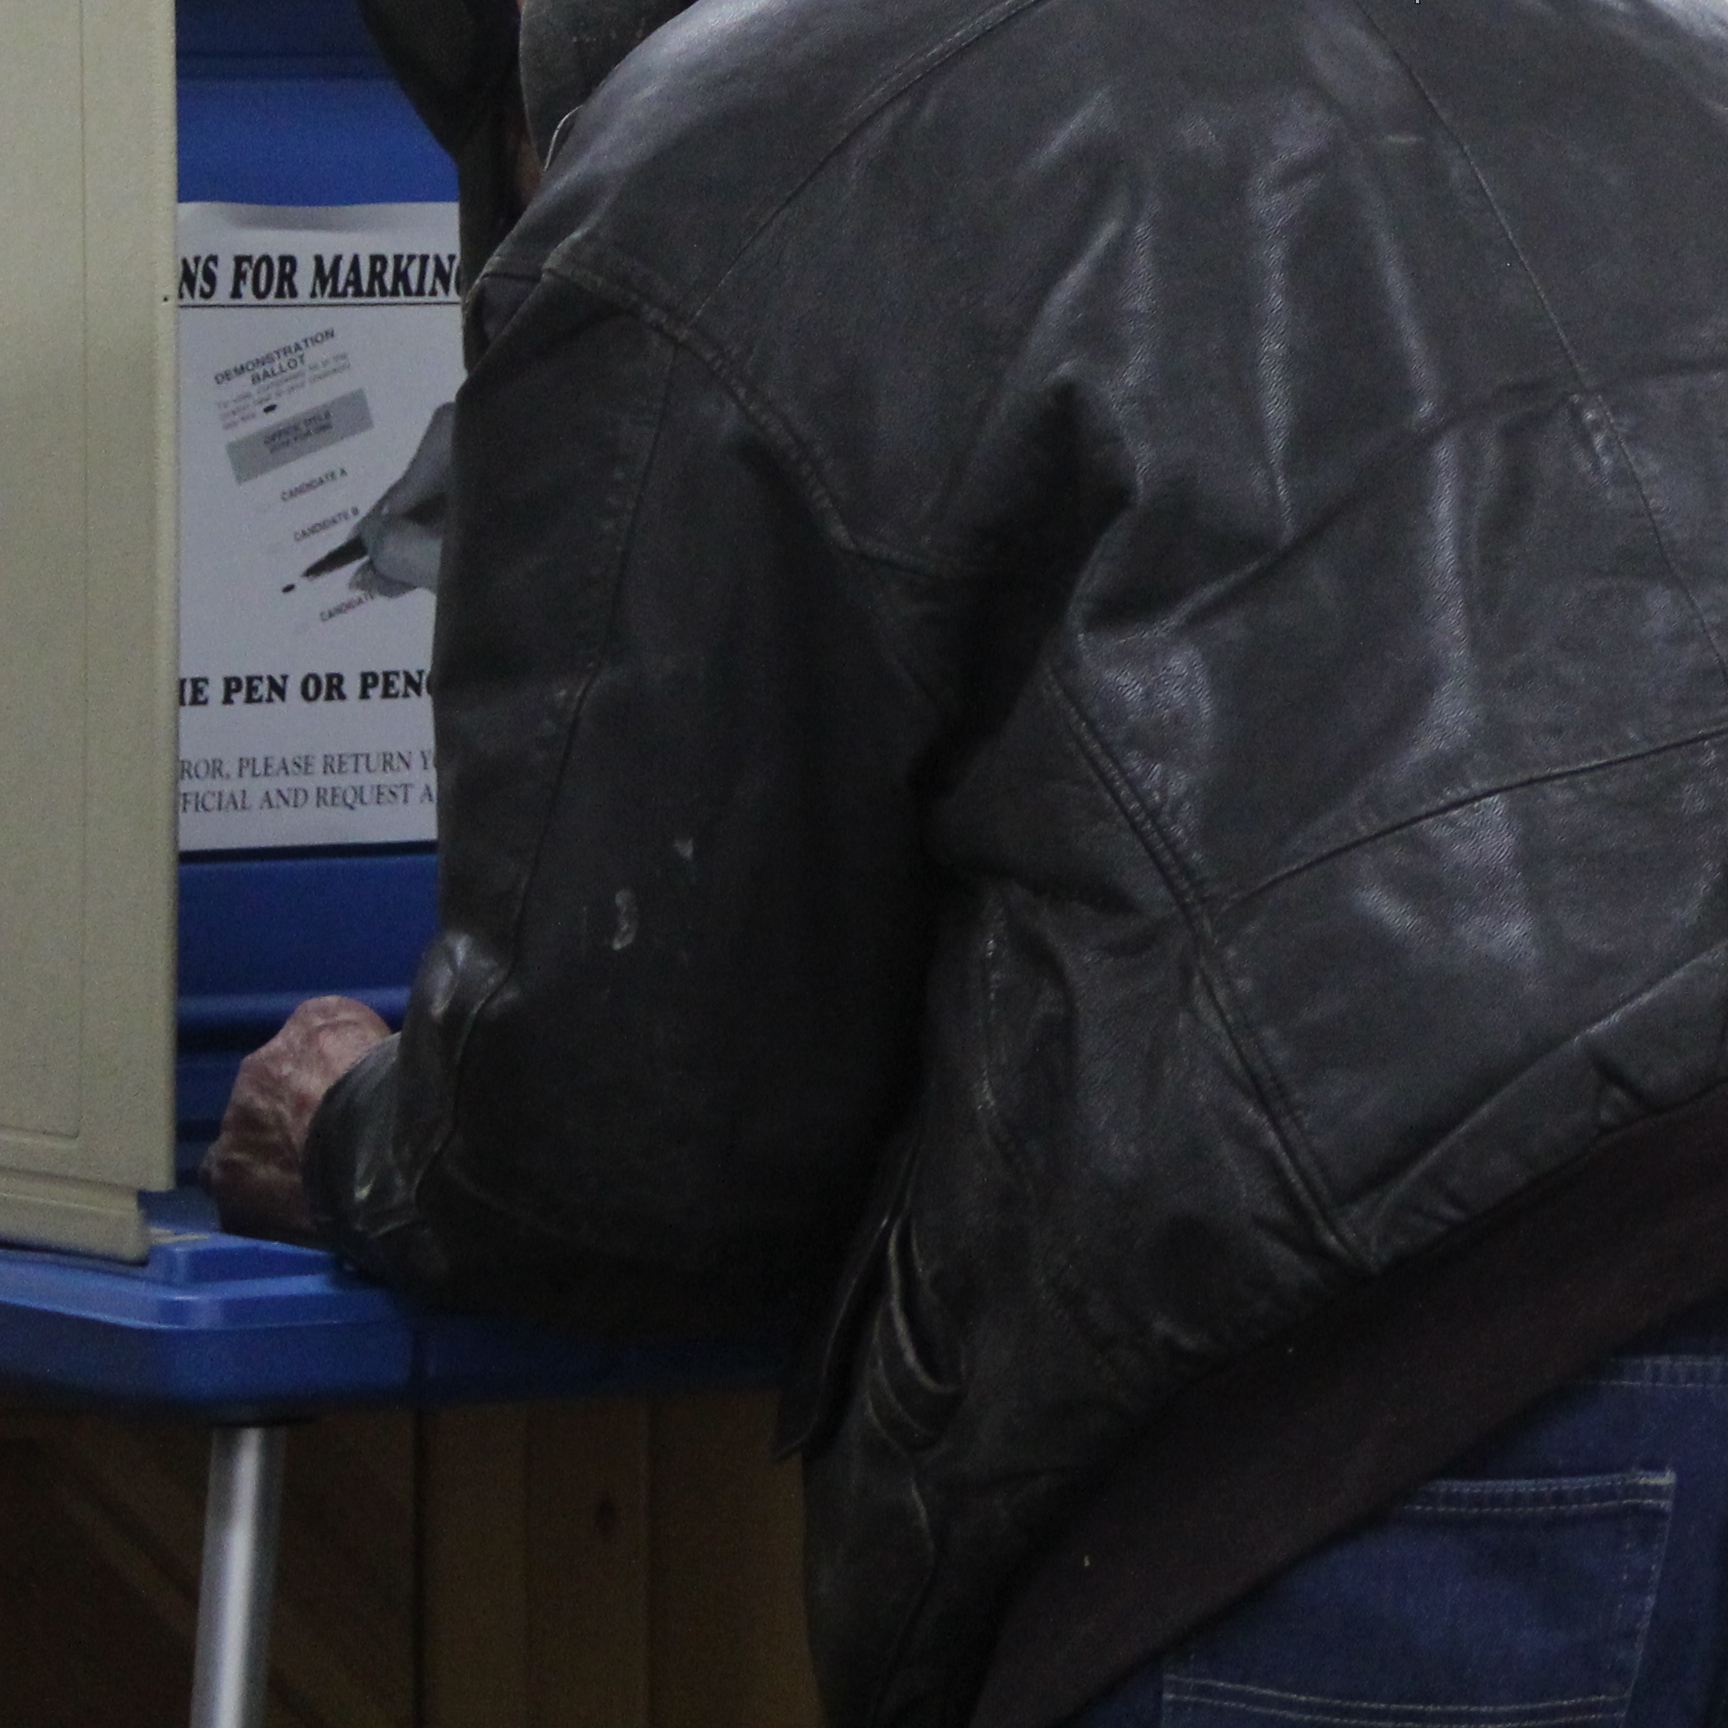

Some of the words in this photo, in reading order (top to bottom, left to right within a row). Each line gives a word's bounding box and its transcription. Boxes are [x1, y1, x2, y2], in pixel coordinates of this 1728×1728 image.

[229, 253, 299, 300] FOR
[213, 327, 336, 386] DEMONSTRATION
[250, 352, 306, 386] BALLOT
[222, 674, 288, 705] PEN
[300, 671, 347, 703] OR
[358, 669, 433, 700] PEN
[238, 754, 315, 779] PLEASE
[323, 750, 413, 775] RETURN
[259, 786, 309, 810] AND
[316, 782, 414, 811] REQUEST
